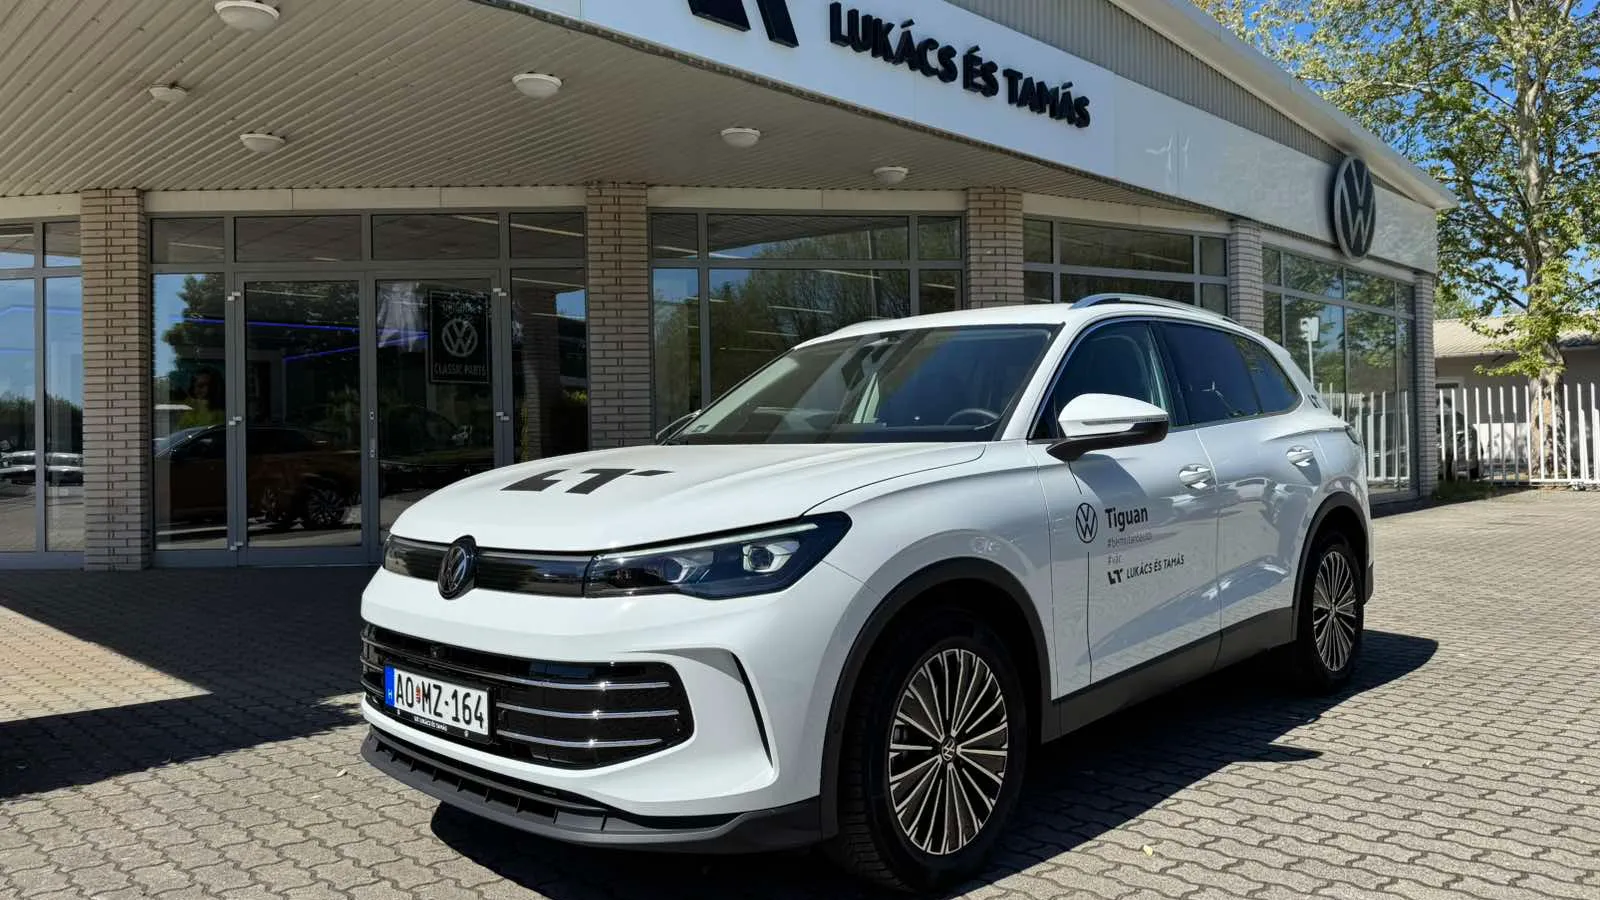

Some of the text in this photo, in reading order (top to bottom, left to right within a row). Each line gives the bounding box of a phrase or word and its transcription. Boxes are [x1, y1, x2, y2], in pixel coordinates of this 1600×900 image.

[830, 2, 957, 83] LUKÁCS
[963, 45, 999, 97] ÉS
[1003, 68, 1090, 128] TAMÁS
[1105, 507, 1148, 532] Tiguan
[1126, 562, 1153, 579] LUKÁCS
[1154, 558, 1162, 572] ÉS
[1163, 552, 1185, 568] TAMÁS
